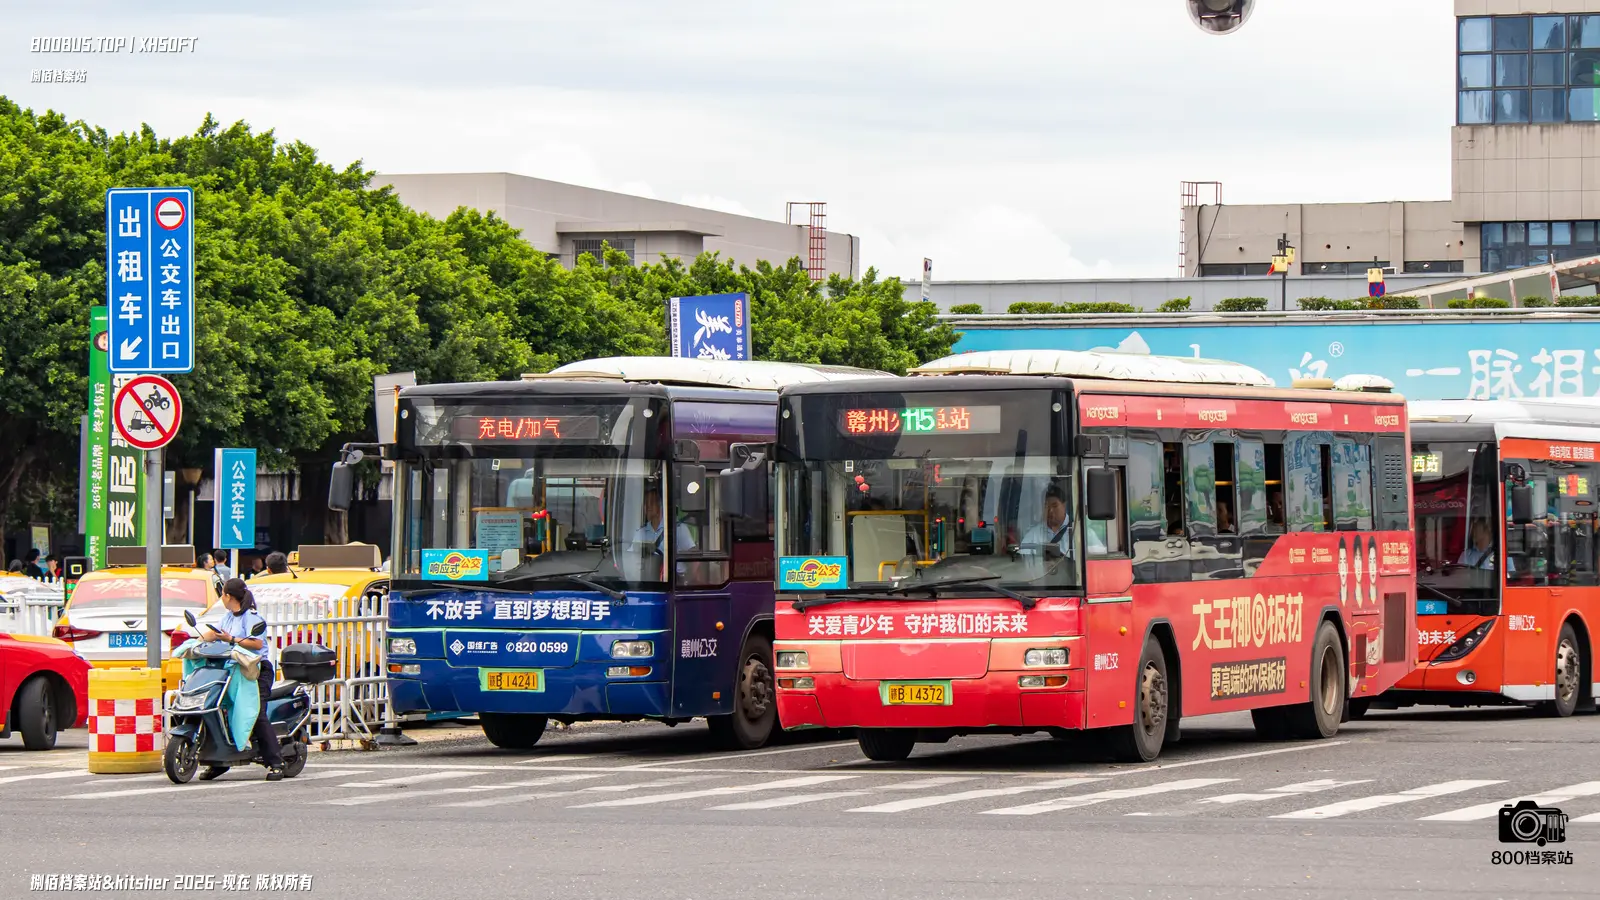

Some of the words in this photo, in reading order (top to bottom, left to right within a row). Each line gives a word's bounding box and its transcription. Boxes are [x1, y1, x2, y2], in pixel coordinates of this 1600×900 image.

[117, 205, 144, 327] 出租车
[159, 237, 182, 360] 公交车出口
[1405, 347, 1600, 400] 一脉相
[478, 417, 560, 439] 充电/加气
[231, 460, 247, 523] 公交车
[426, 600, 482, 621] 不放手
[494, 599, 611, 621] 直到梦想到手
[808, 614, 894, 636] 关爱青少年
[904, 612, 1028, 634] 守护我们的未来
[515, 642, 537, 653] 820
[540, 642, 568, 653] 0599
[1211, 660, 1286, 697] 更高端的环保板材
